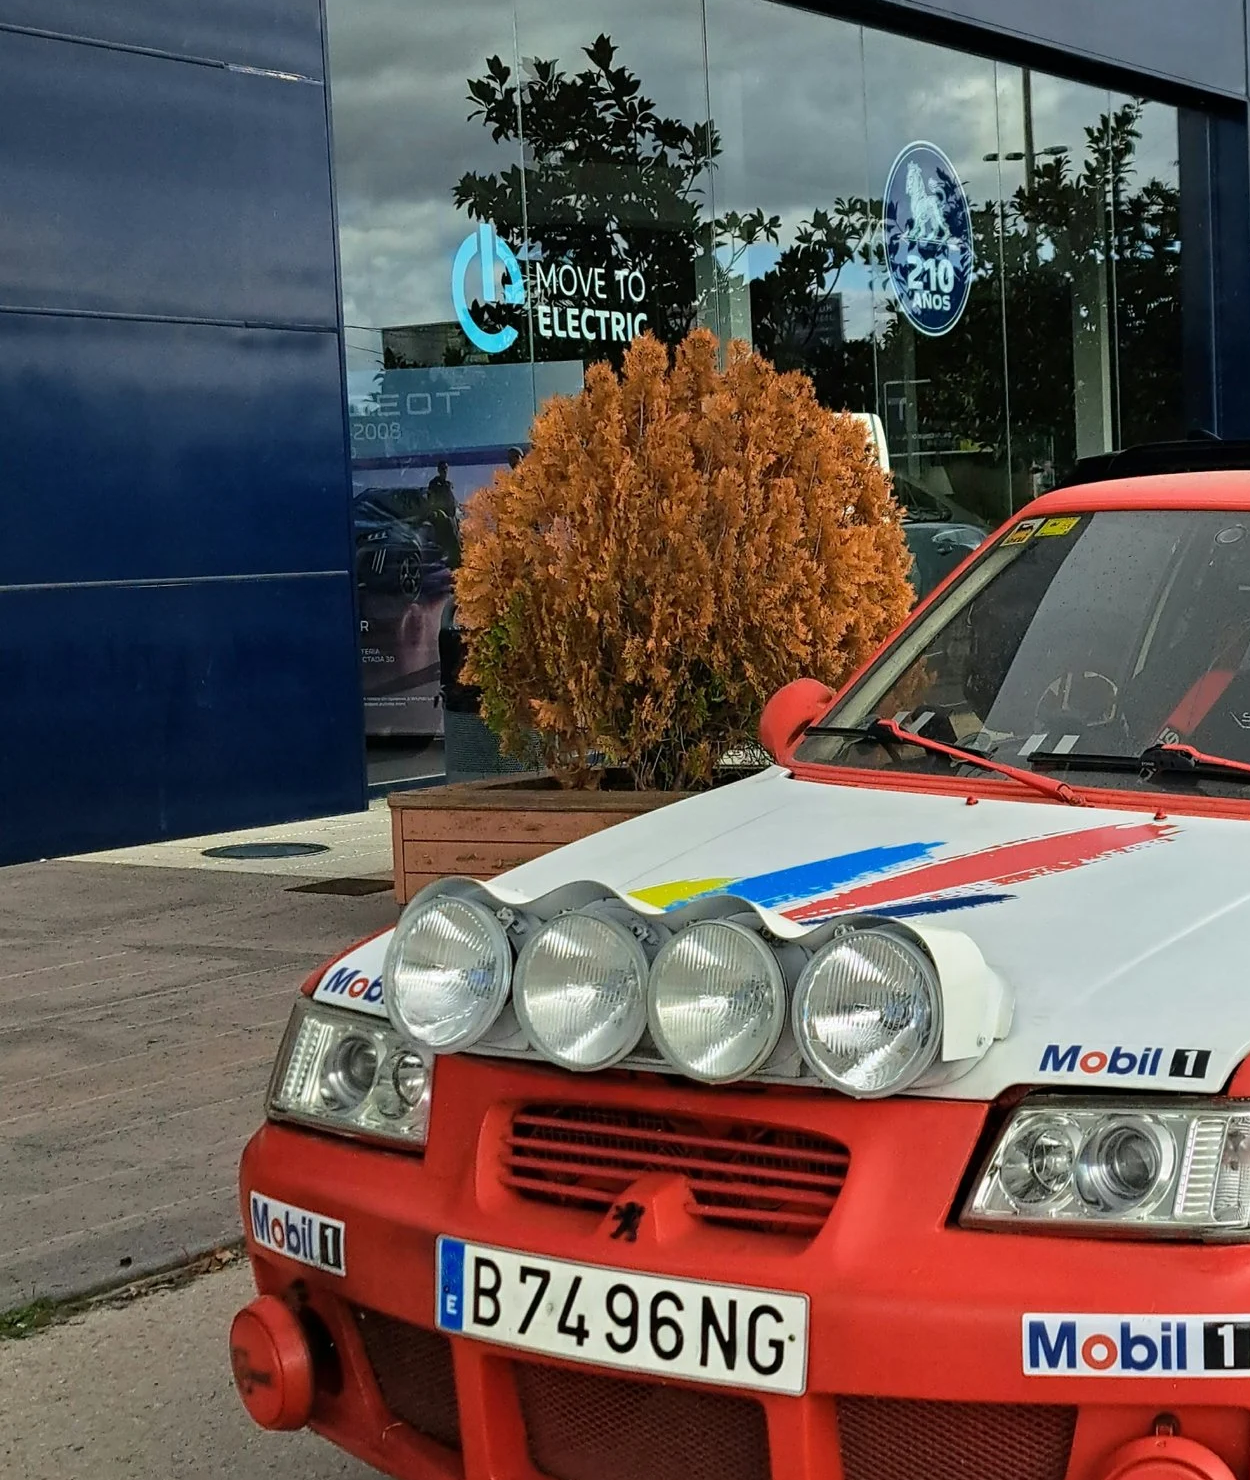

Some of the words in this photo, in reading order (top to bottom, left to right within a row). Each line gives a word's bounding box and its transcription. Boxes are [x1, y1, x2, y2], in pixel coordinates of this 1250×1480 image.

[536, 262, 607, 298] MOVE
[614, 270, 646, 302] TO
[907, 255, 955, 293] 210
[913, 290, 951, 311] AÑOS
[1039, 1045, 1163, 1076] Mobil
[253, 1198, 313, 1260] Mobil
[446, 1294, 457, 1314] E
[1029, 1321, 1187, 1370] Mobil
